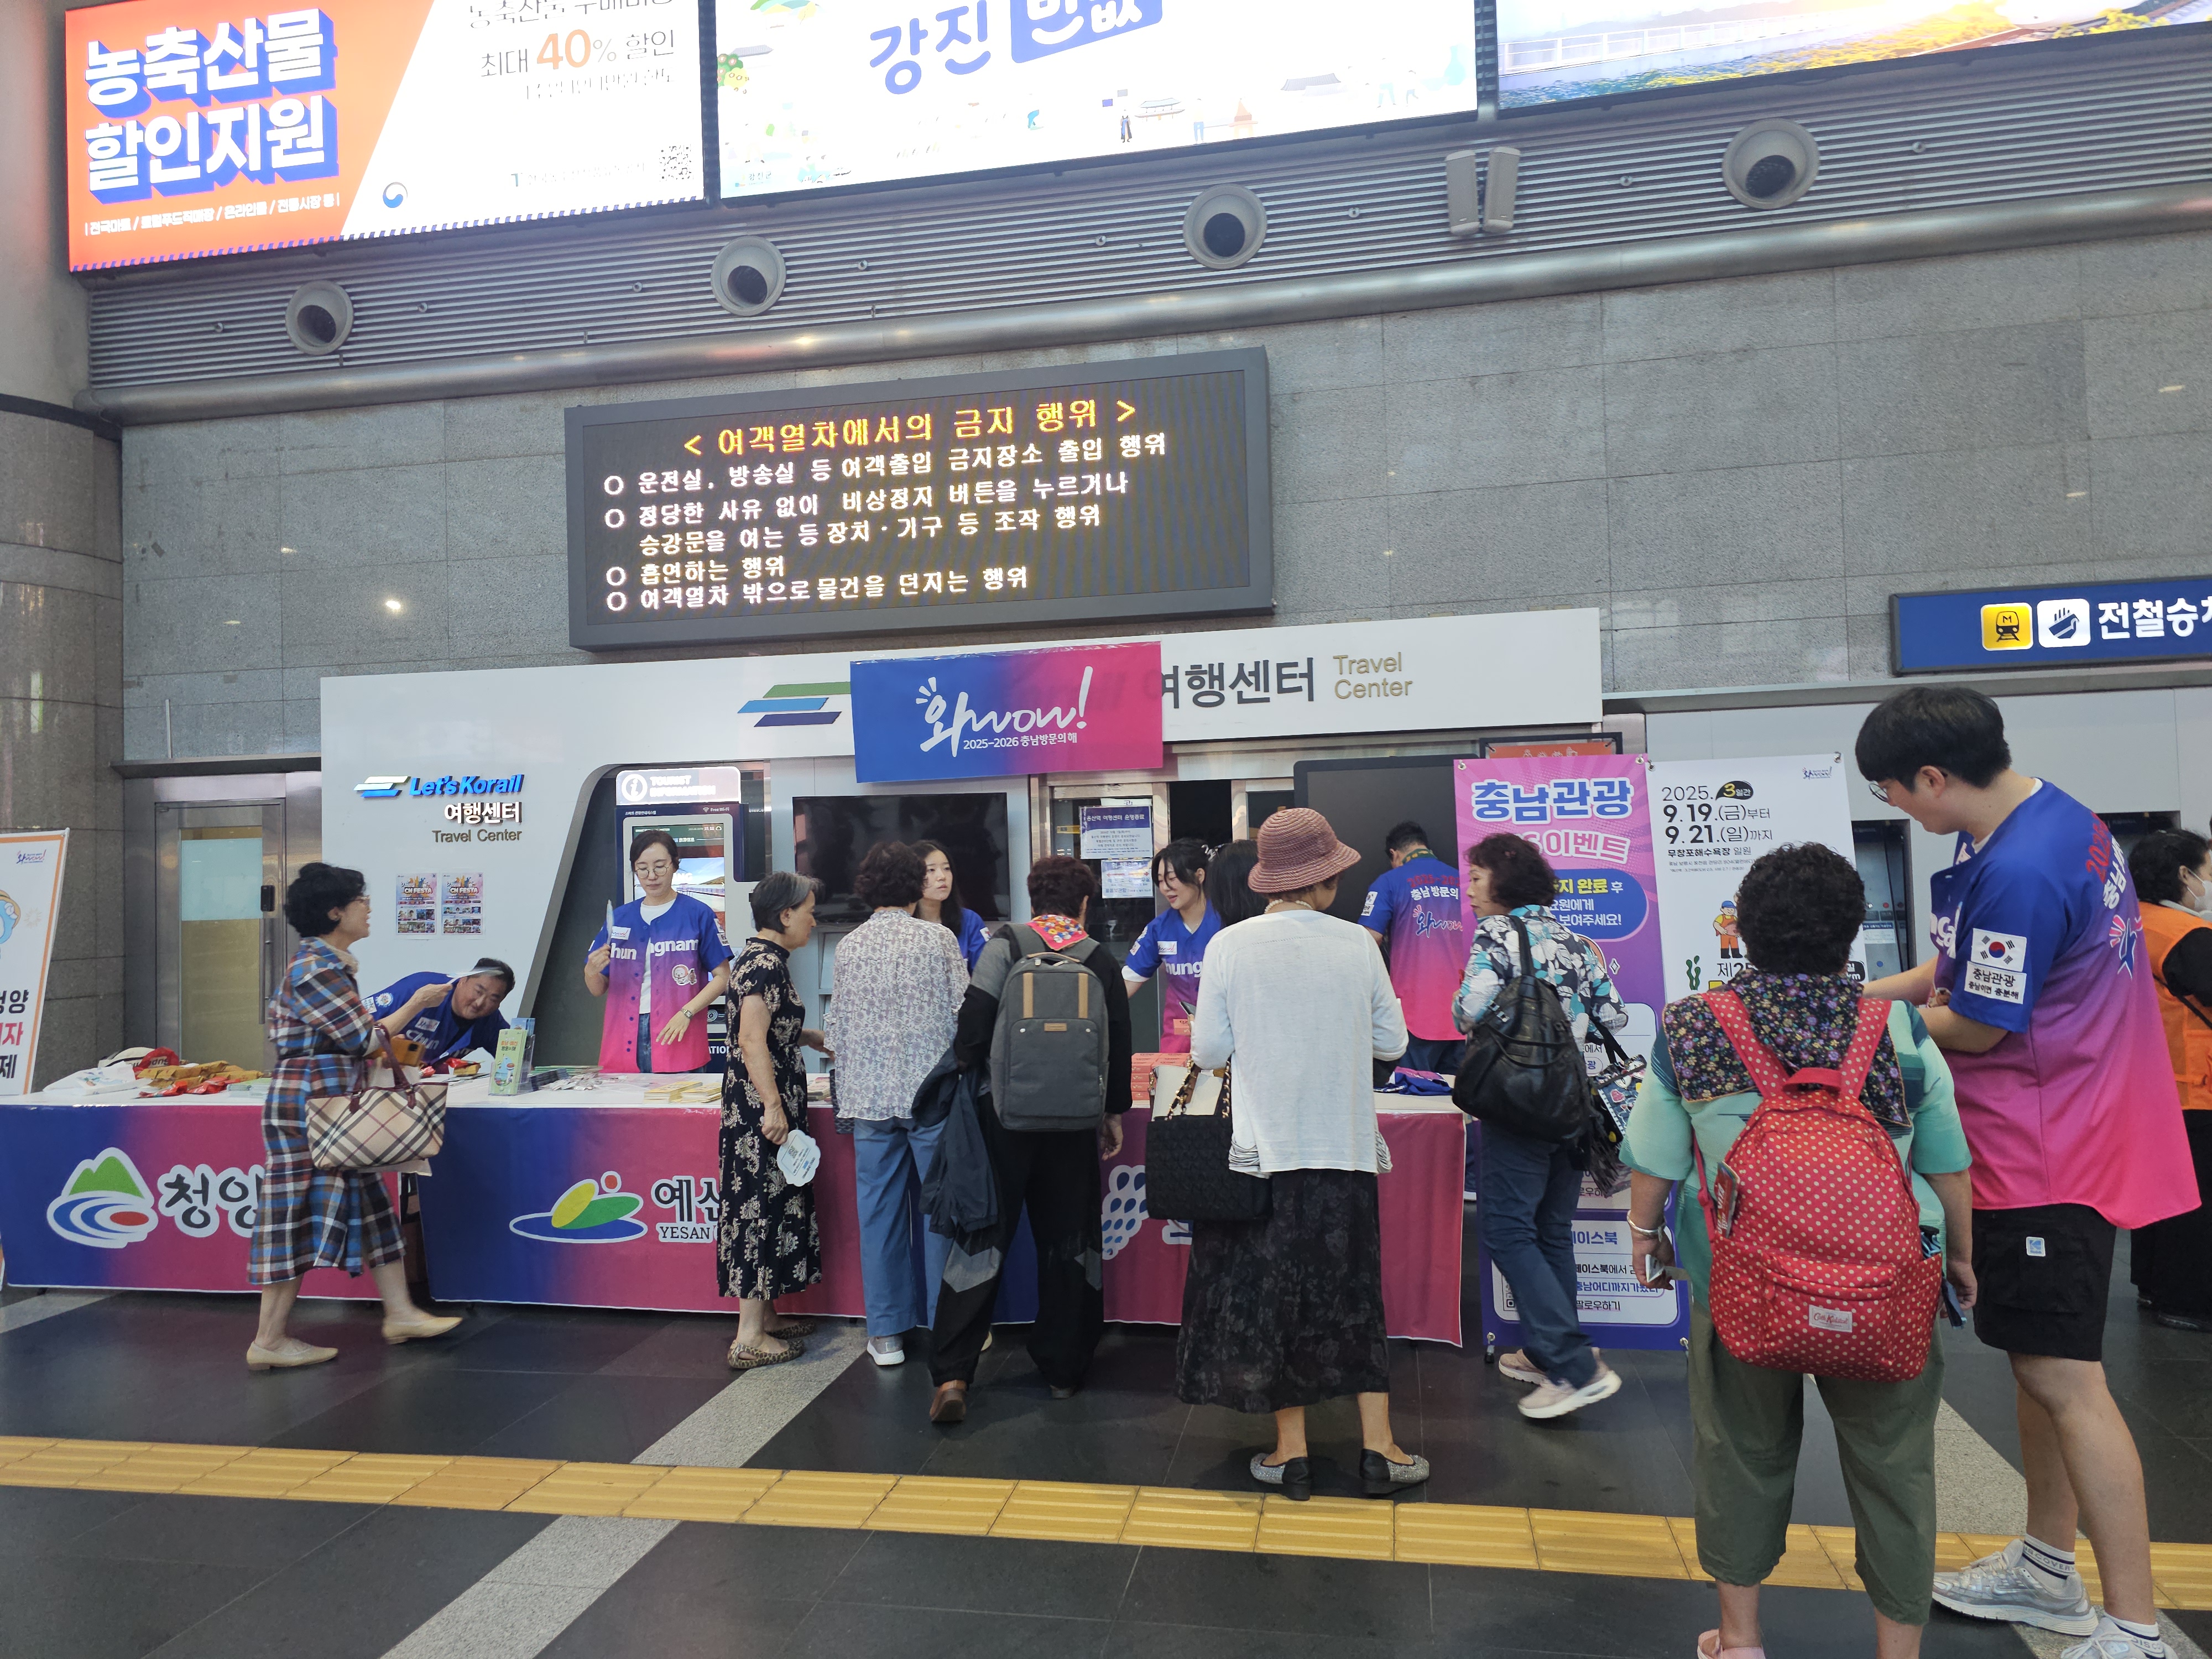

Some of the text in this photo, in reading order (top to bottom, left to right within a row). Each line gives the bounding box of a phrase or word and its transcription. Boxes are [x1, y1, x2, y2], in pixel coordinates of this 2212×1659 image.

[85, 8, 324, 106] 농축산물
[481, 29, 674, 77] 최대 40% 할인
[870, 0, 991, 95] 강진
[85, 95, 325, 192] 할인지원
[718, 414, 932, 455] 여객열차에서의
[954, 406, 1013, 439] 금지
[1036, 399, 1097, 432] 행위
[729, 462, 795, 487] 방송실
[811, 458, 832, 481] 등
[842, 451, 932, 478] 여객출입
[948, 444, 1043, 472] 금지장소
[1058, 437, 1103, 463] 출입
[1119, 432, 1166, 458] 행위
[639, 471, 1129, 527] 정당한 사유 없이 비상정지 버튼을 누르거나
[640, 529, 726, 556] 승강문을
[739, 527, 784, 549] 여는
[798, 524, 818, 546] 등
[958, 512, 979, 535] 등
[995, 508, 1041, 532] 조작
[1055, 504, 1100, 529] 행위
[640, 555, 785, 586] 흡연하는 행위
[640, 566, 1027, 609] 여객열차 밖으로 물건을 던지는 행위
[2098, 596, 2212, 640] 전철승
[1333, 652, 1402, 675] Travel
[1334, 679, 1413, 700] Center
[963, 737, 1019, 750] 2025-2026
[410, 774, 523, 795] Let's Korail
[650, 775, 691, 786] TOURIST
[1473, 779, 1632, 823] 충남관광
[1662, 786, 1713, 801] 2025.
[444, 802, 521, 824] 여행센터
[432, 829, 521, 842] Travel Center
[1577, 878, 1609, 894] 완료
[1610, 881, 1624, 894] 후
[1559, 914, 1621, 926] 보여주세요!
[1973, 968, 2016, 987] 충남관광
[659, 1226, 711, 1240] YESAN
[1572, 1231, 1618, 1245] 이스북
